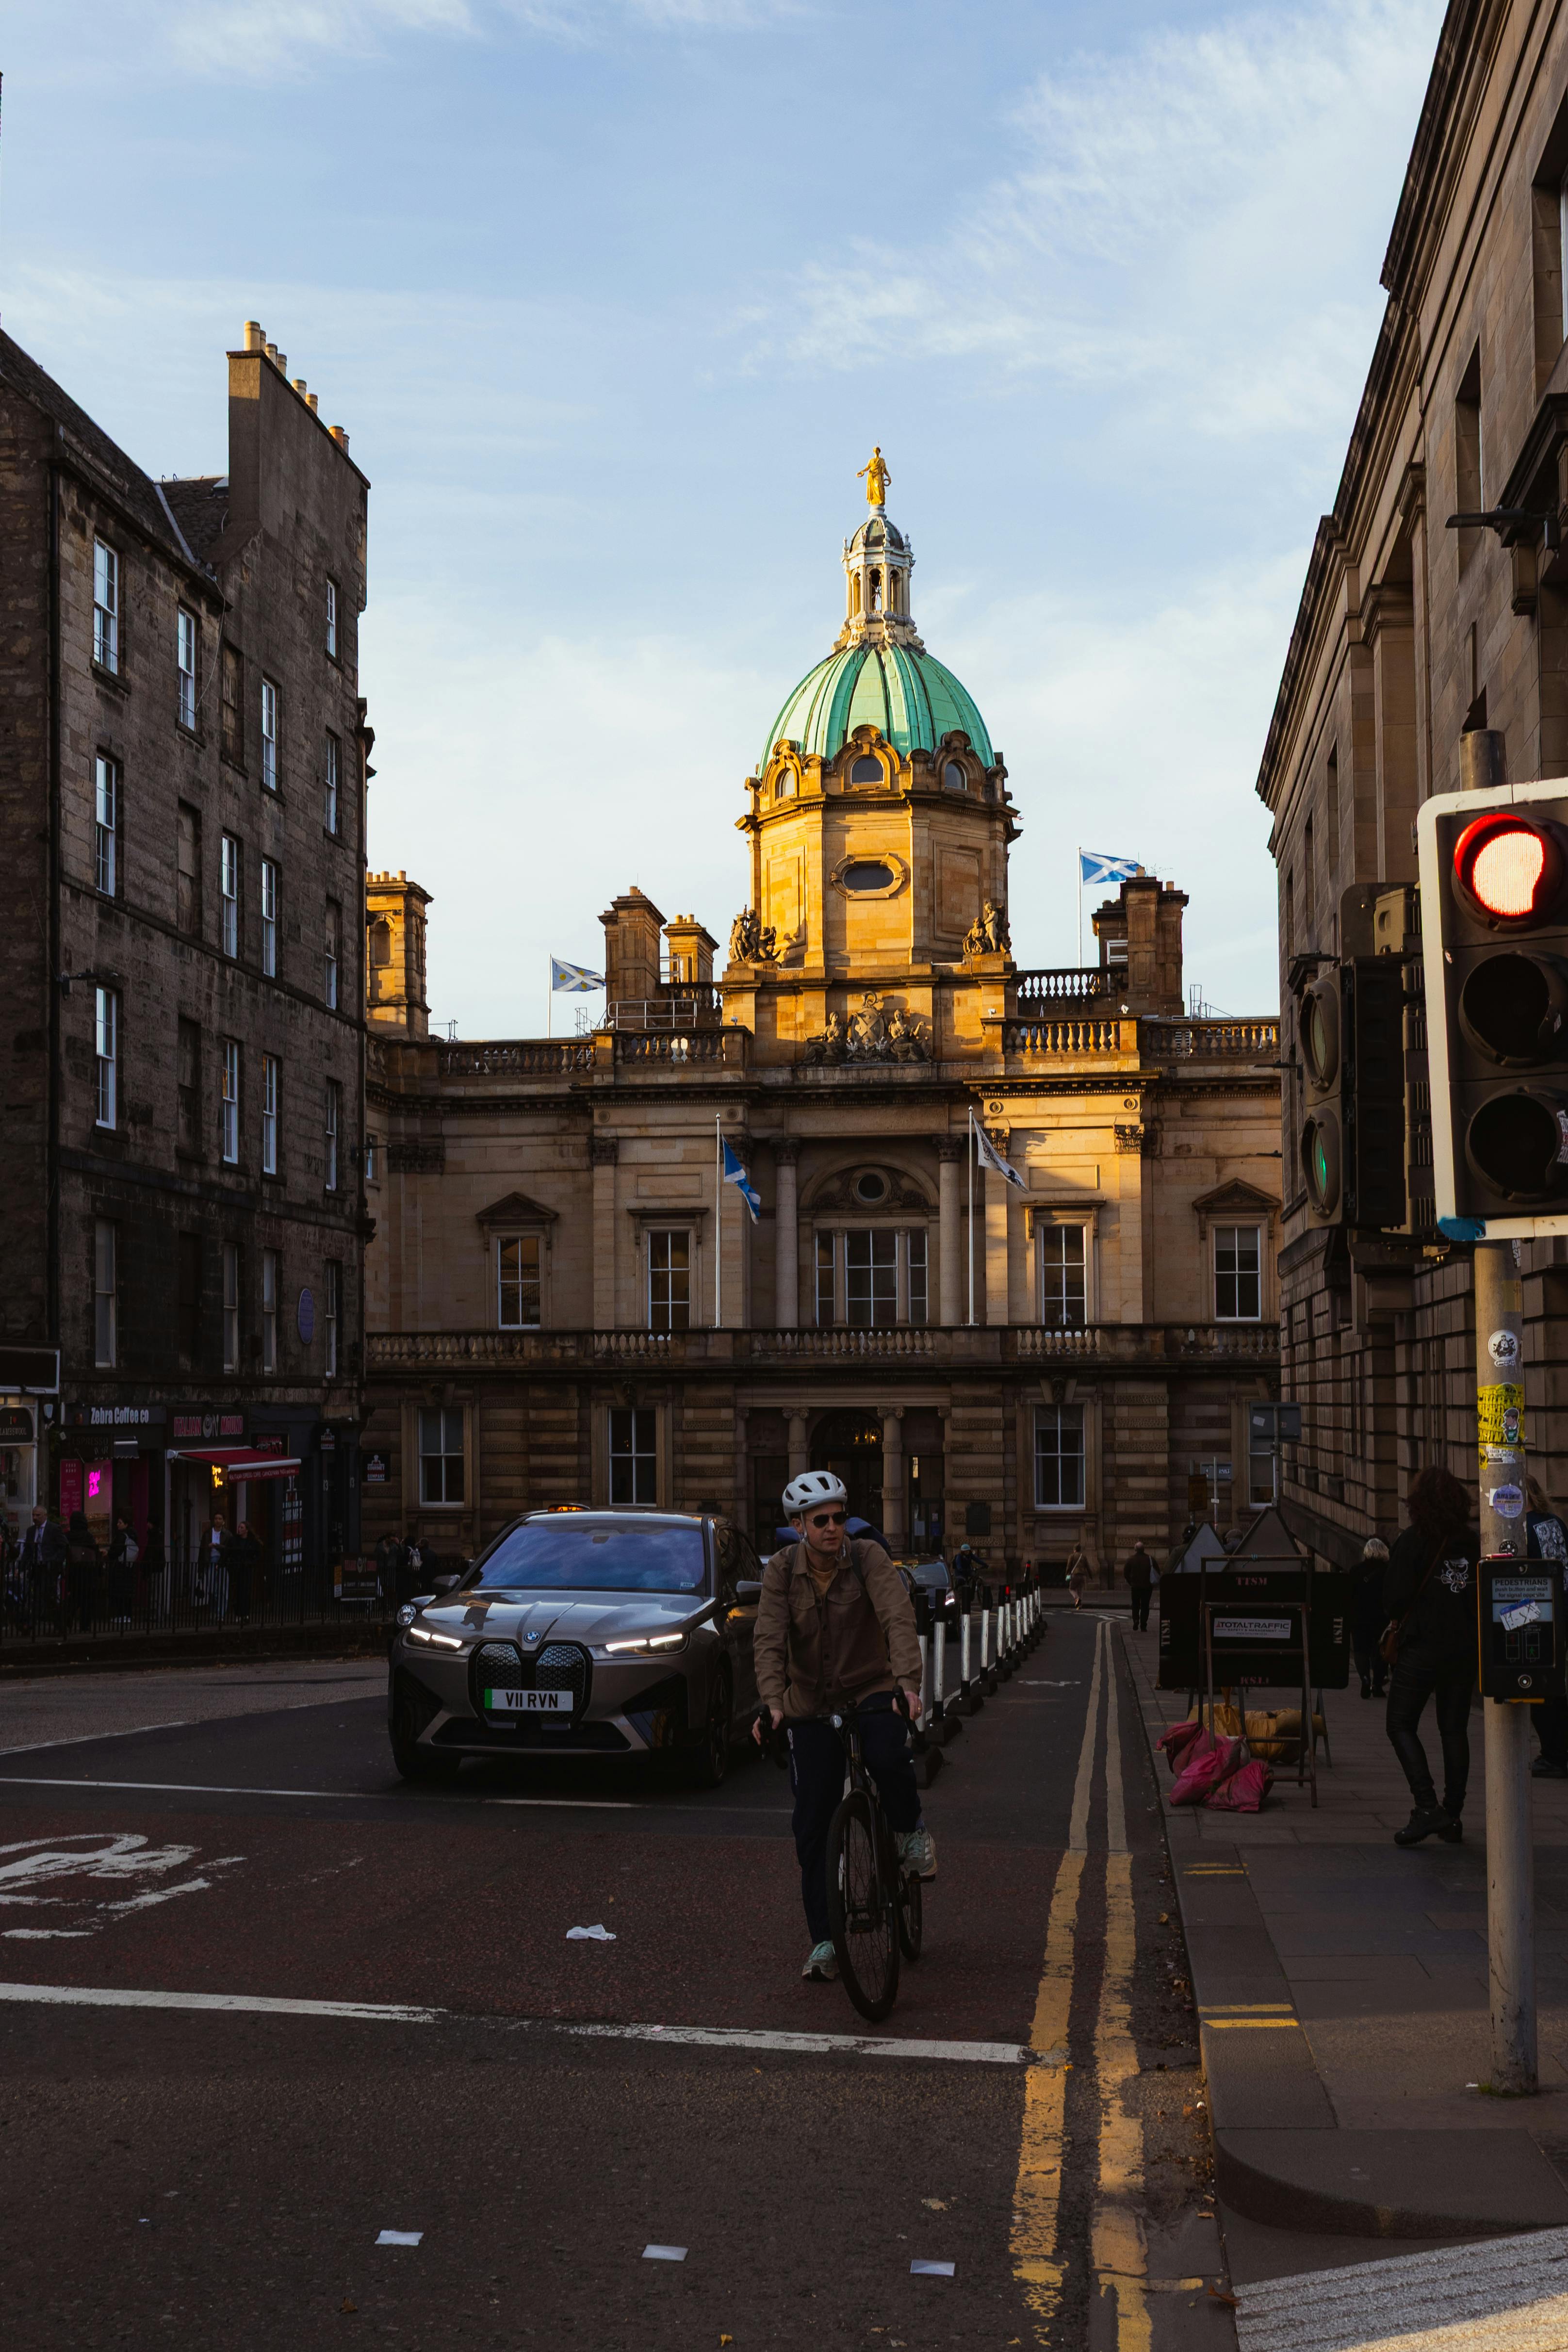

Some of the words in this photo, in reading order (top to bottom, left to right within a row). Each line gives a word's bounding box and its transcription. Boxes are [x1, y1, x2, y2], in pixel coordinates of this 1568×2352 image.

[91, 1406, 113, 1424] Zebra
[114, 1406, 139, 1424] Coffee
[140, 1409, 149, 1424] co
[174, 1416, 202, 1437] ITALIAN
[220, 1415, 244, 1435] MOUND
[1236, 1576, 1268, 1586] TTSM
[527, 1693, 558, 1708] RVN
